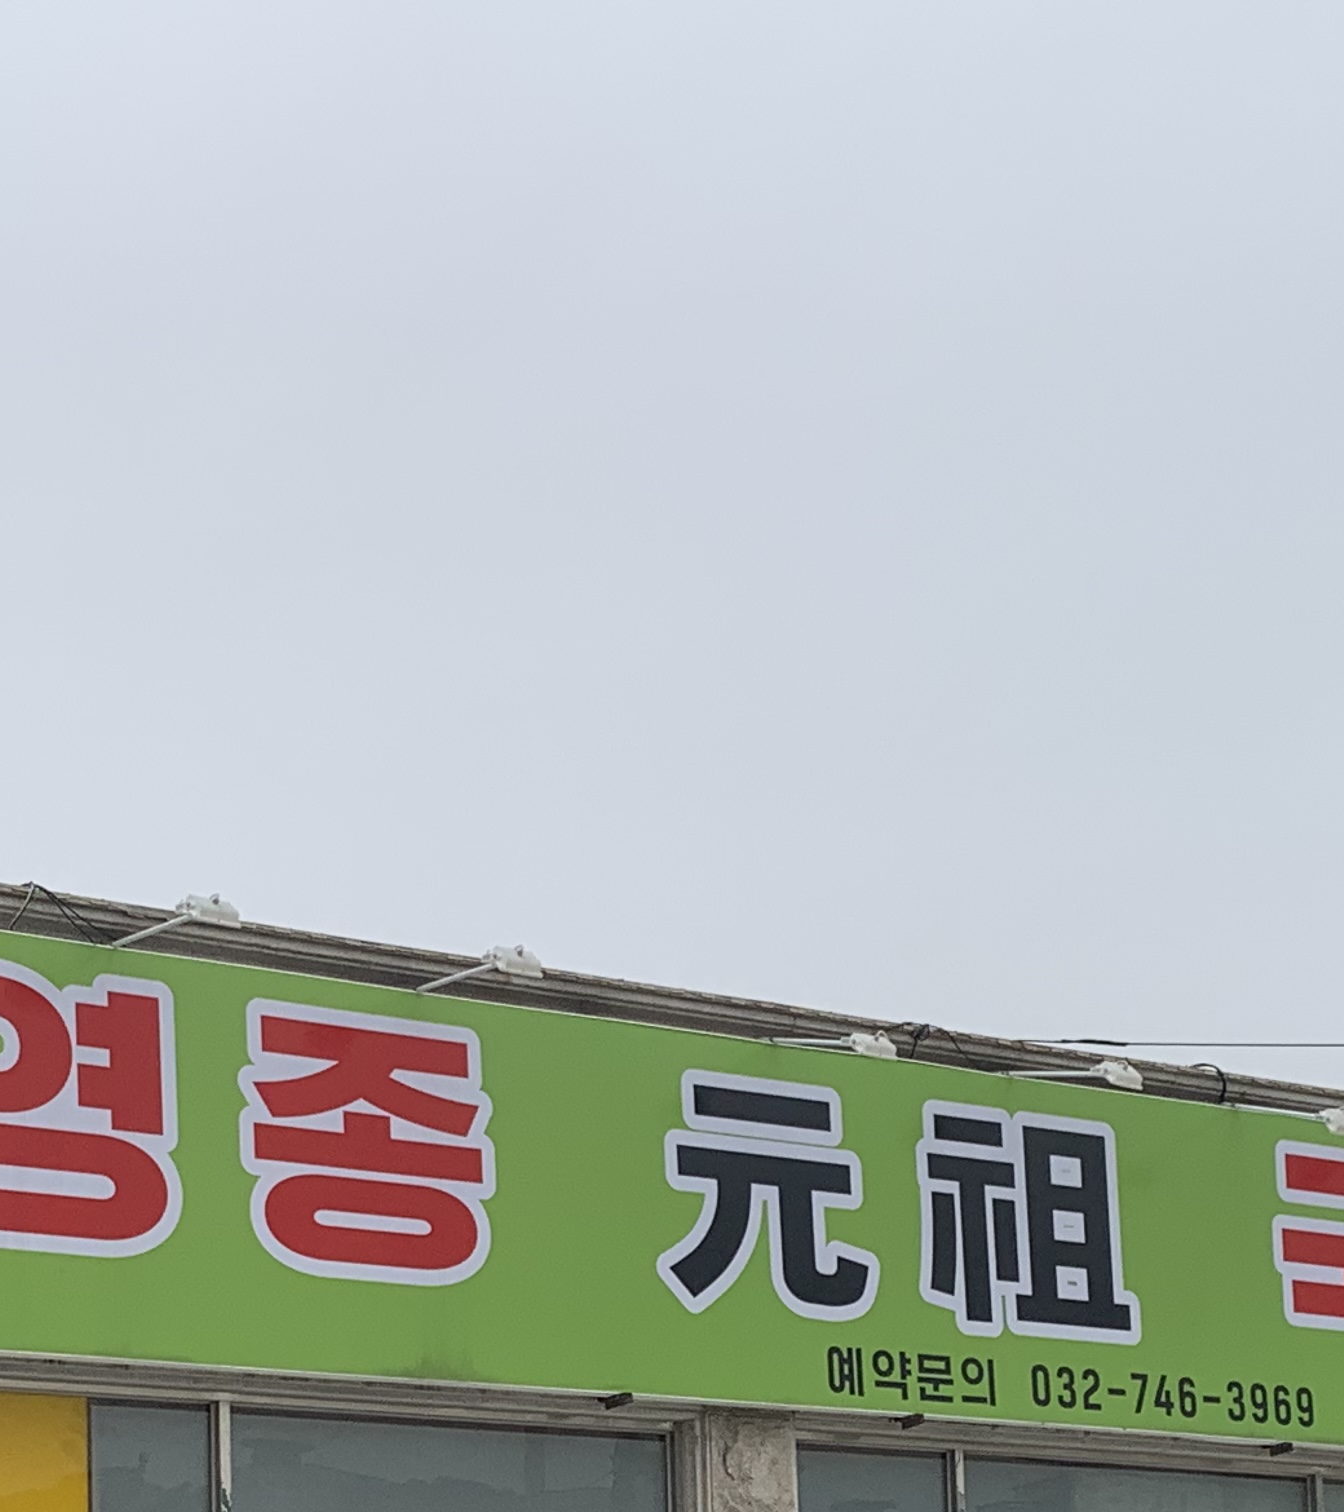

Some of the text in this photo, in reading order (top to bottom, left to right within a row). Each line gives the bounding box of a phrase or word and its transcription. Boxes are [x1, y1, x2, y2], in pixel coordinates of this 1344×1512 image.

[656, 1069, 1141, 1345] 元祖
[827, 1346, 1316, 1428] 예약문의 032-746-3969
